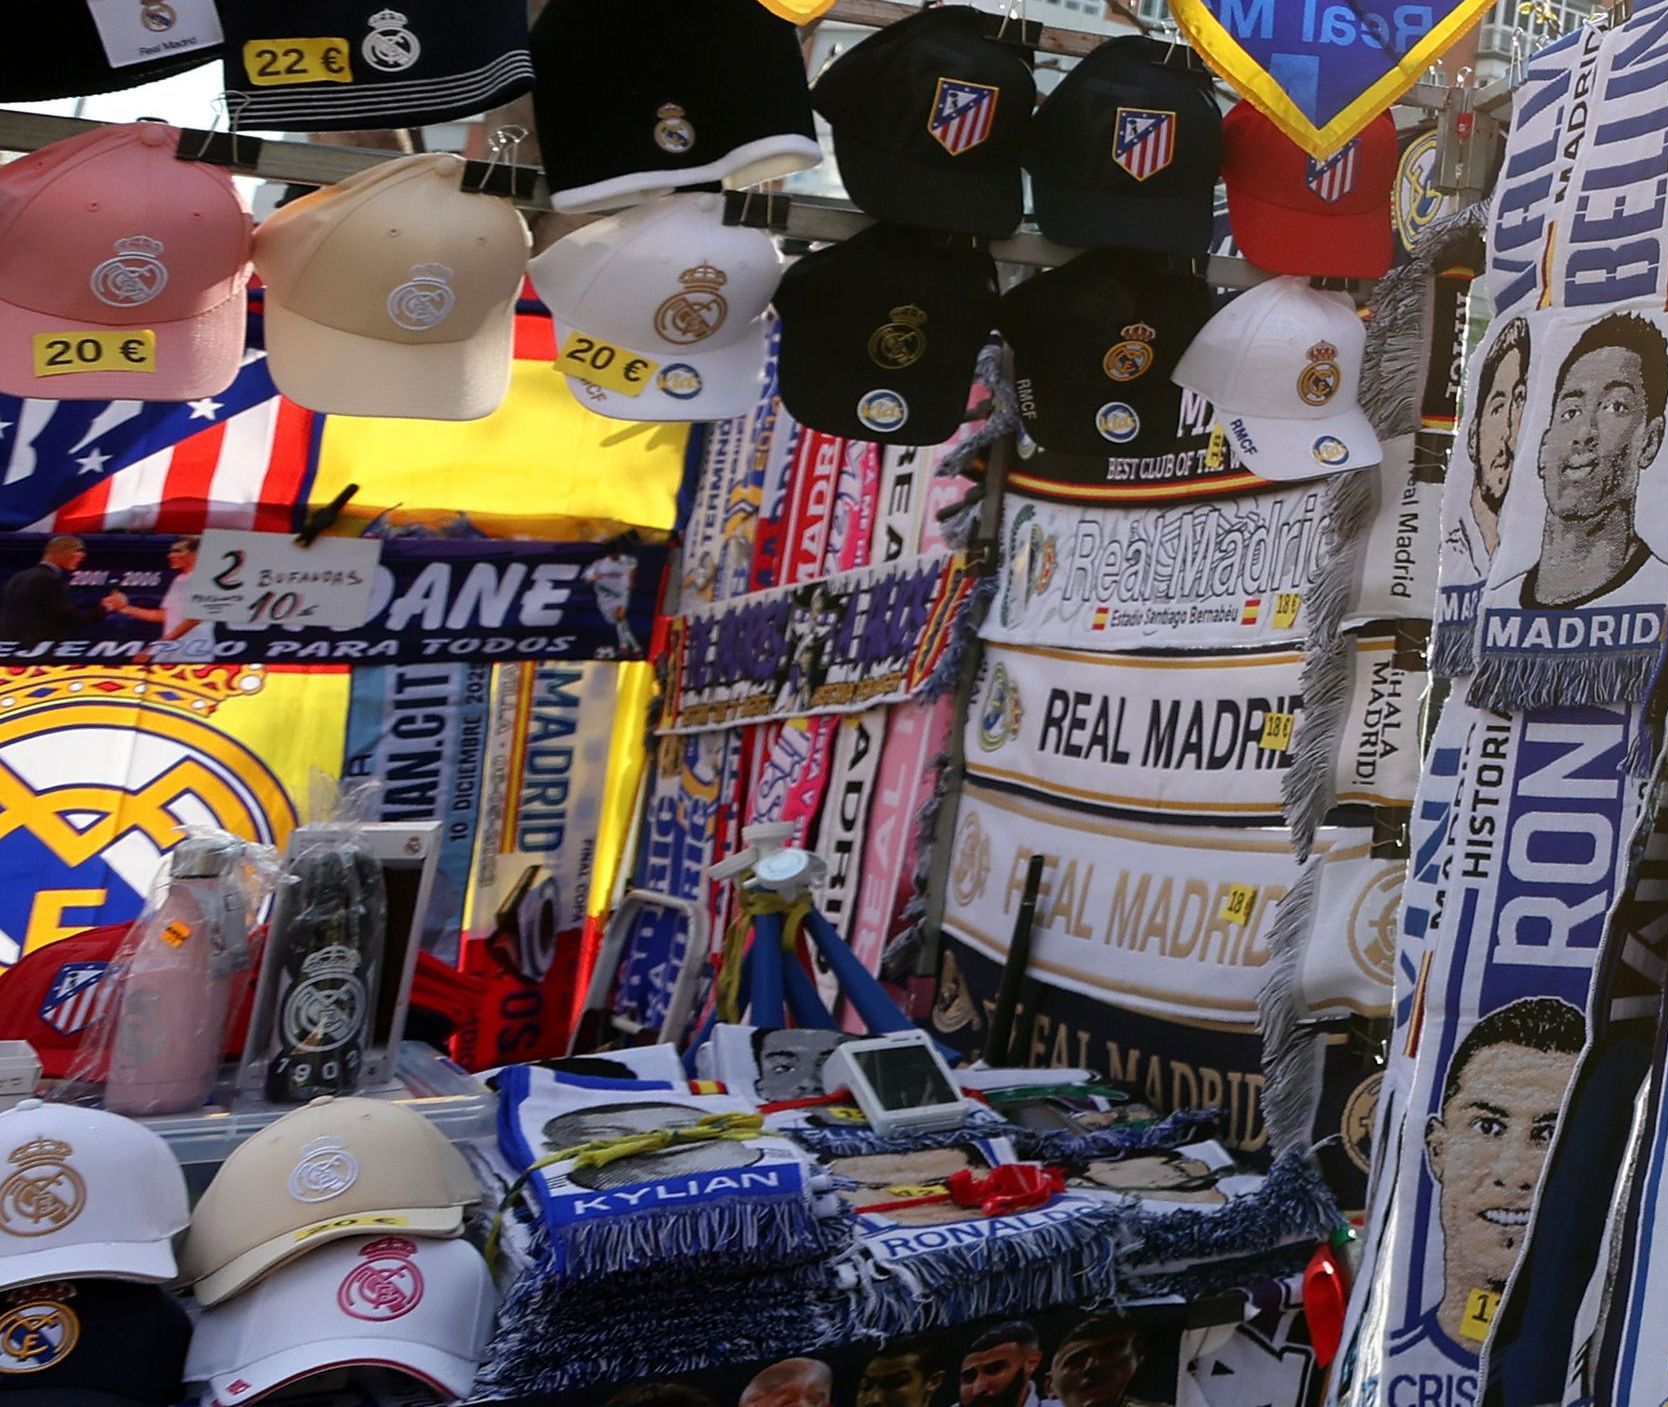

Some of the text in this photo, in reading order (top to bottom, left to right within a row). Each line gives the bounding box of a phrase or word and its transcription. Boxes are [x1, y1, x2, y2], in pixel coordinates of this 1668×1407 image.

[255, 46, 346, 78] 22 €
[1553, 22, 1609, 204] MADRID
[44, 338, 148, 368] 20 €
[565, 337, 649, 383] 20 €
[1015, 378, 1038, 420] RMCF
[1229, 418, 1259, 456] RMCF
[1106, 456, 1139, 480] BEST
[1139, 454, 1174, 479] CLUB
[1175, 453, 1193, 477] OF
[212, 550, 246, 591] 2
[1062, 516, 1164, 603] Real
[1389, 513, 1420, 600] Madrid
[1110, 604, 1239, 630] Estadio Santiago Bernabéu
[1276, 594, 1290, 615] 18
[266, 638, 400, 659] PARA
[420, 634, 577, 656] TODOS
[1487, 611, 1661, 650] MADRID
[1037, 687, 1130, 766] REAL
[1266, 716, 1281, 739] 18
[1356, 661, 1390, 787] MADRID!
[454, 714, 482, 812] DICIEMBRE
[518, 667, 584, 853] MADRID
[452, 823, 468, 841] 10
[569, 838, 594, 923] FINAL COPA
[1228, 889, 1245, 915] 18
[574, 1170, 780, 1215] KYLIAN
